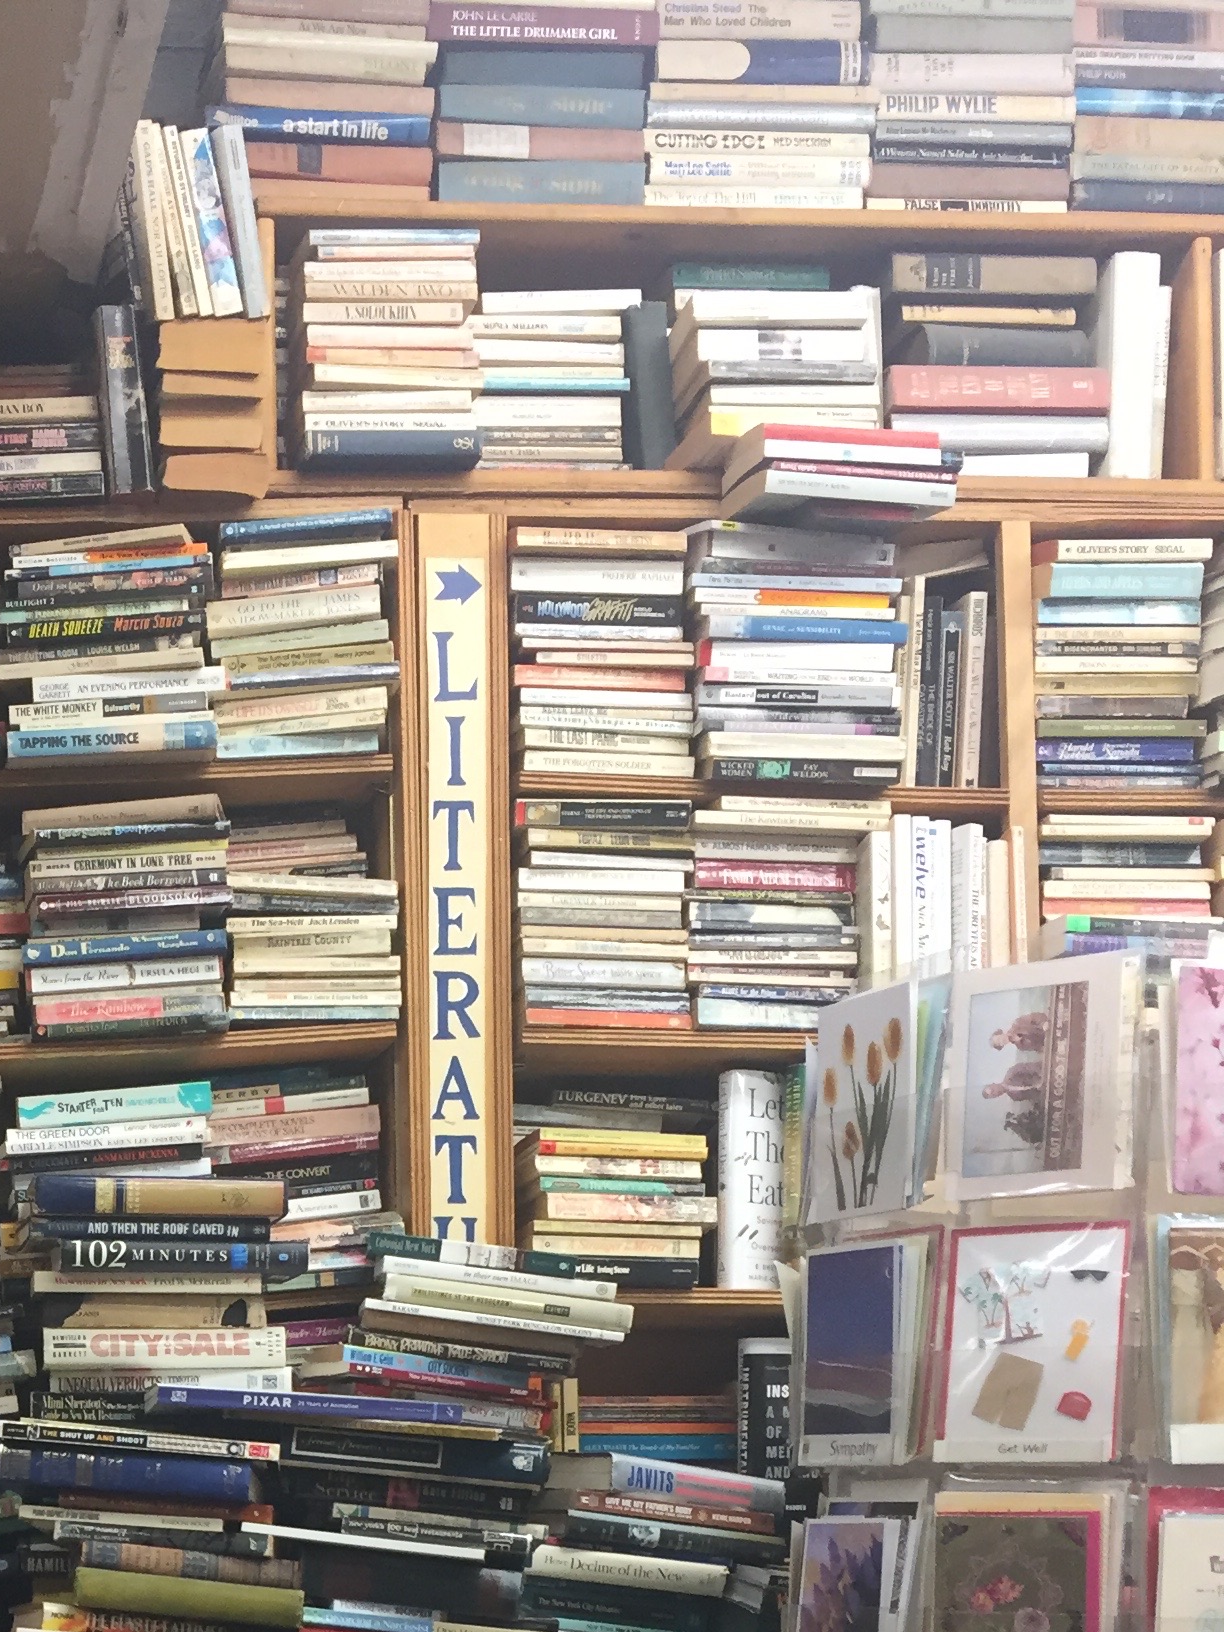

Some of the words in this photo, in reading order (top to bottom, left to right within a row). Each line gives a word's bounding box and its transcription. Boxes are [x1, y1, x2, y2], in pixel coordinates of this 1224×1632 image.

[451, 24, 477, 38] THE
[479, 25, 520, 39] LITTLE
[524, 26, 587, 40] DRUMMER
[589, 27, 619, 40] GIRL
[886, 95, 939, 114] PHILIP
[946, 96, 997, 115] WYLIE
[282, 120, 294, 133] a
[297, 118, 338, 138] start
[341, 120, 356, 138] in
[360, 121, 389, 141] life
[654, 133, 717, 149] CUTTING
[721, 134, 765, 150] EDGE
[29, 622, 60, 639] DEATH
[62, 617, 103, 637] SQUEEZE
[113, 615, 150, 632] Marcio
[15, 706, 32, 717] THE
[34, 705, 62, 717] WHITE
[62, 702, 97, 716] MONKEY
[18, 735, 77, 749] TAPPING
[79, 734, 96, 747] THE
[97, 732, 139, 746] SOURCE
[74, 858, 123, 871] CEREMONY
[126, 857, 136, 869] IN
[140, 855, 164, 868] LONE
[167, 854, 192, 866] TREE
[559, 1090, 625, 1106] TURGENEV
[16, 1129, 36, 1140] THE
[39, 1128, 76, 1139] GREEN
[78, 1125, 111, 1138] DOOR
[88, 1223, 108, 1235] AND
[111, 1223, 137, 1235] THEN
[141, 1223, 160, 1235] THE
[162, 1223, 189, 1235] ROOF
[192, 1223, 224, 1236] CAVED
[226, 1226, 239, 1238] IN
[71, 1239, 128, 1269] 102
[132, 1249, 228, 1262] MINUTES
[90, 1333, 164, 1357] CITY
[171, 1333, 250, 1357] SALE
[244, 1394, 291, 1408] PIXAR
[828, 1440, 879, 1462] Sympathy
[998, 1443, 1017, 1455] Get
[1021, 1442, 1048, 1454] Well
[627, 1465, 675, 1494] JAVITS
